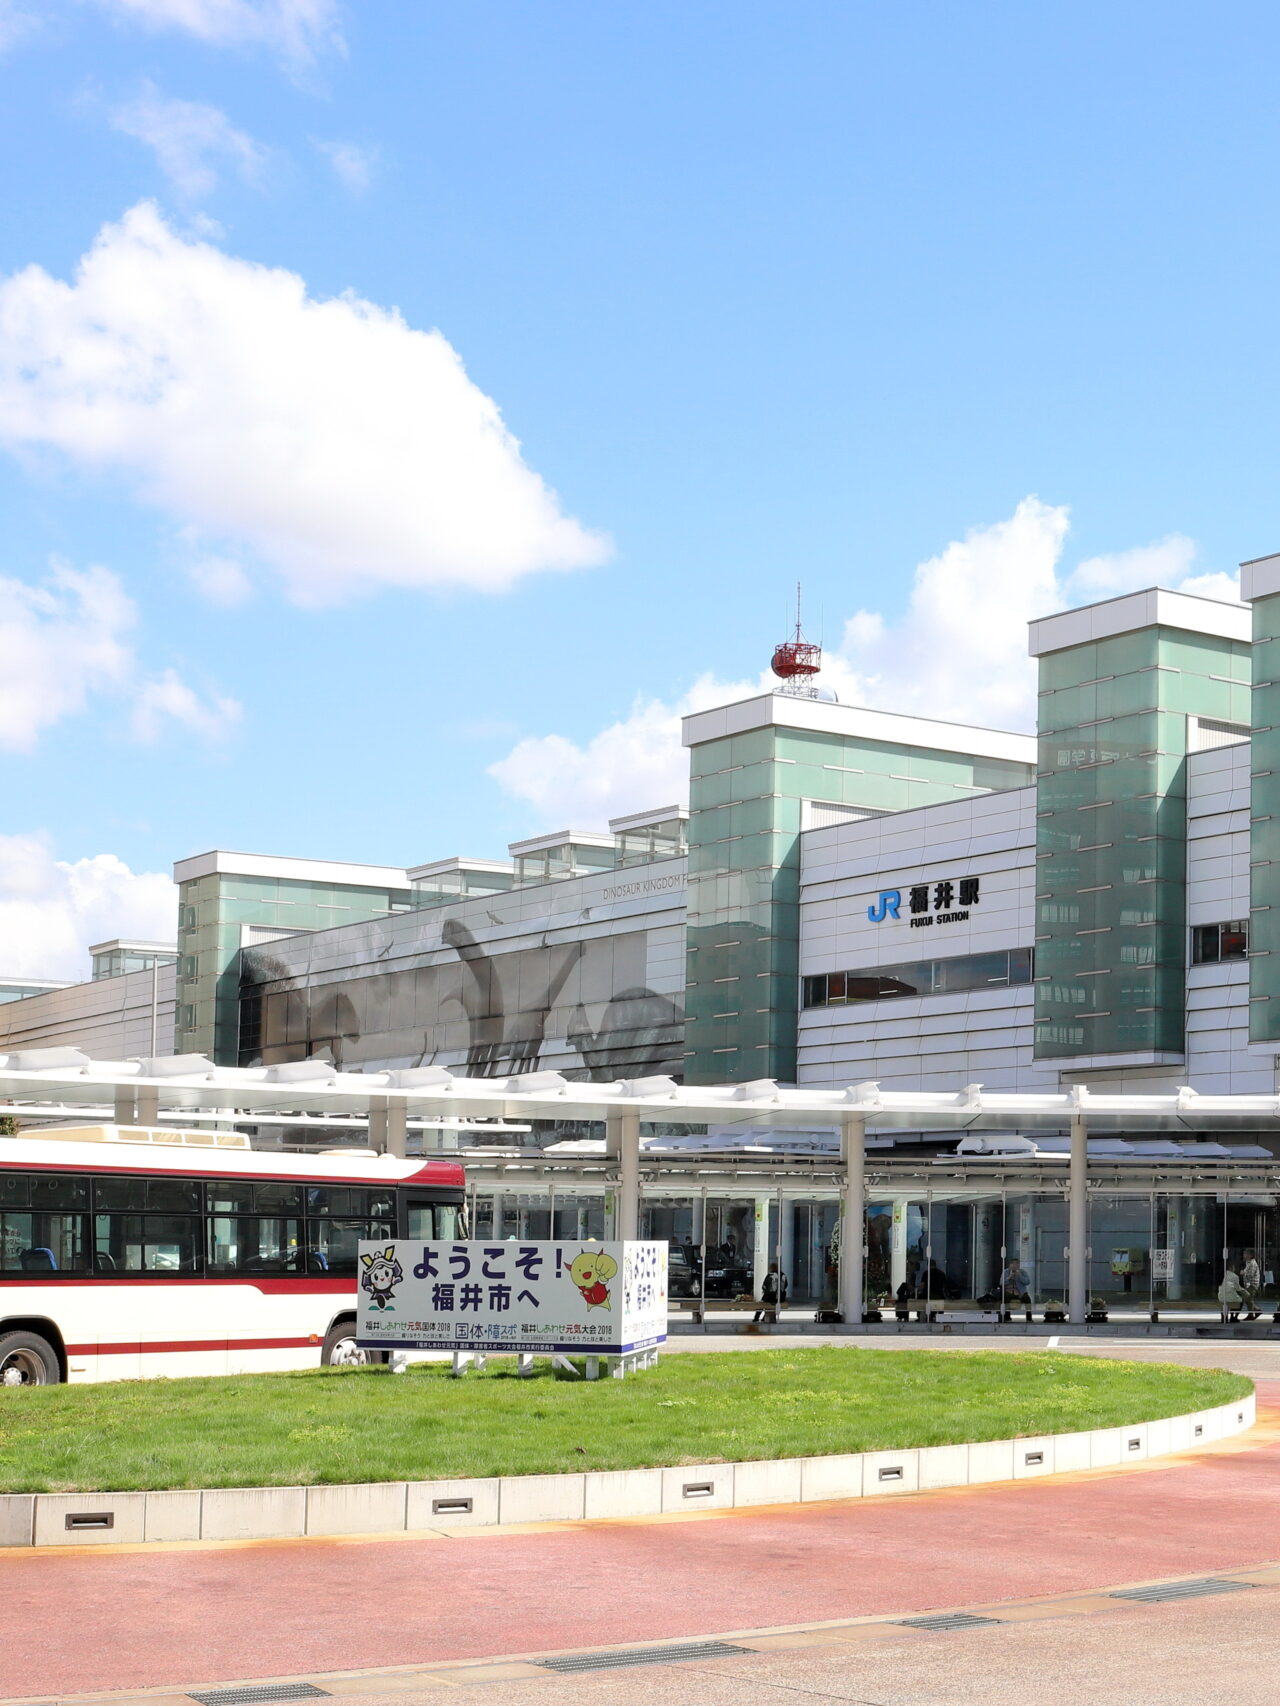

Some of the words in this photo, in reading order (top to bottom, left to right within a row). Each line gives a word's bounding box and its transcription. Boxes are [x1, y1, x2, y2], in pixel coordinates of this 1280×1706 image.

[603, 883, 640, 900] DINOSAUR
[643, 876, 681, 892] KINGDOM
[909, 878, 979, 914] 福井駅
[868, 890, 901, 922] JR
[910, 916, 933, 928] FUKUI
[936, 911, 969, 925] STATION
[432, 1283, 540, 1312] 福井市へ
